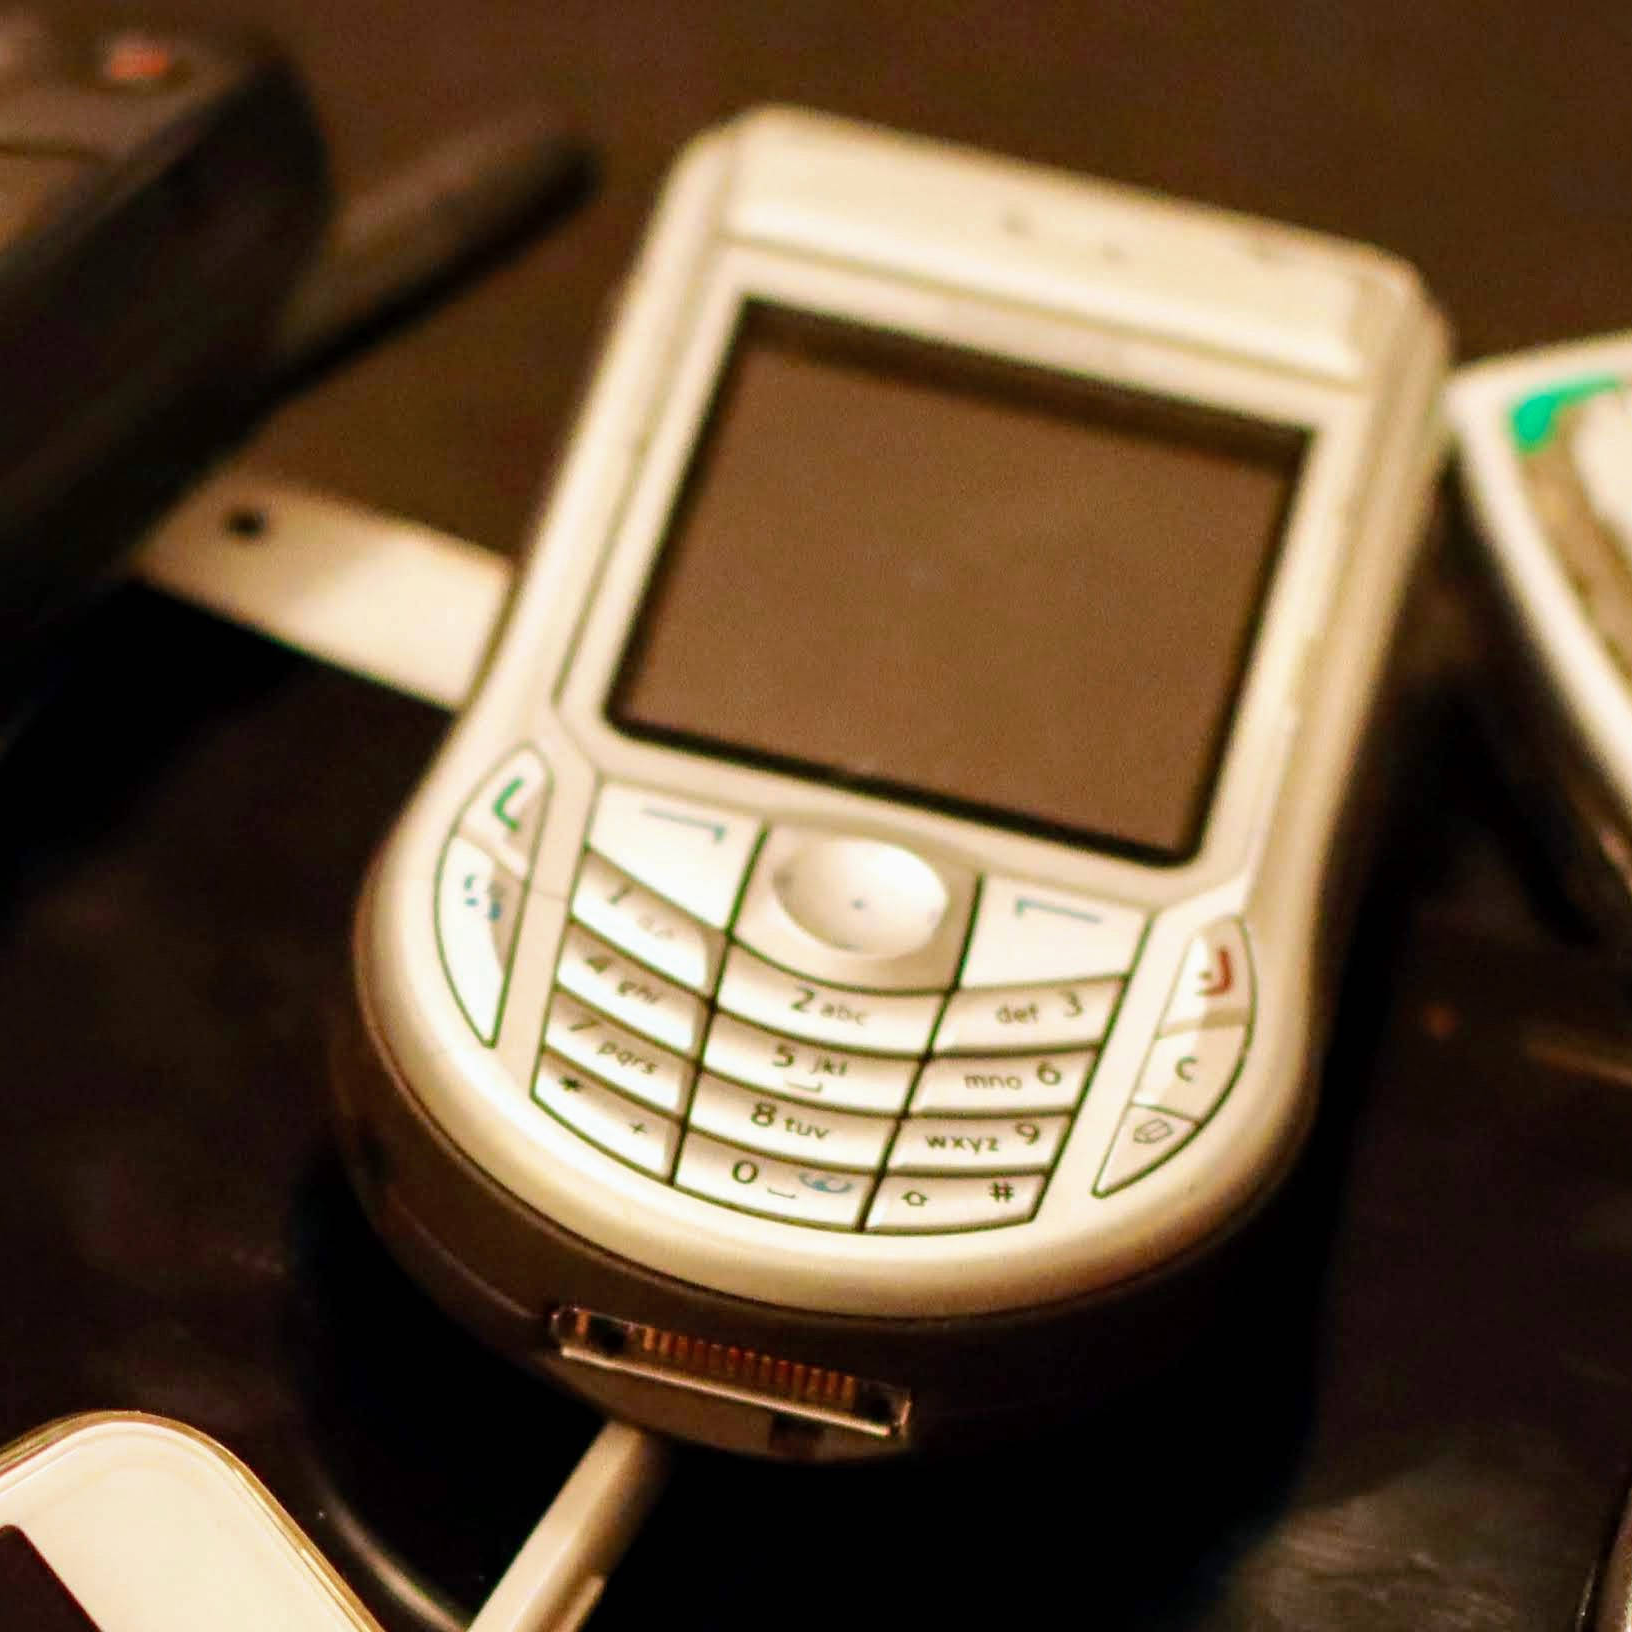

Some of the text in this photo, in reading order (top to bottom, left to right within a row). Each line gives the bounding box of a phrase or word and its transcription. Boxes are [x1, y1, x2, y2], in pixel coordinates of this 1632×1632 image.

[790, 985, 816, 1015] 2
[771, 1044, 795, 1069] 5
[1035, 1060, 1063, 1087] 6
[750, 1101, 779, 1128] 8
[1015, 1122, 1041, 1146] 9
